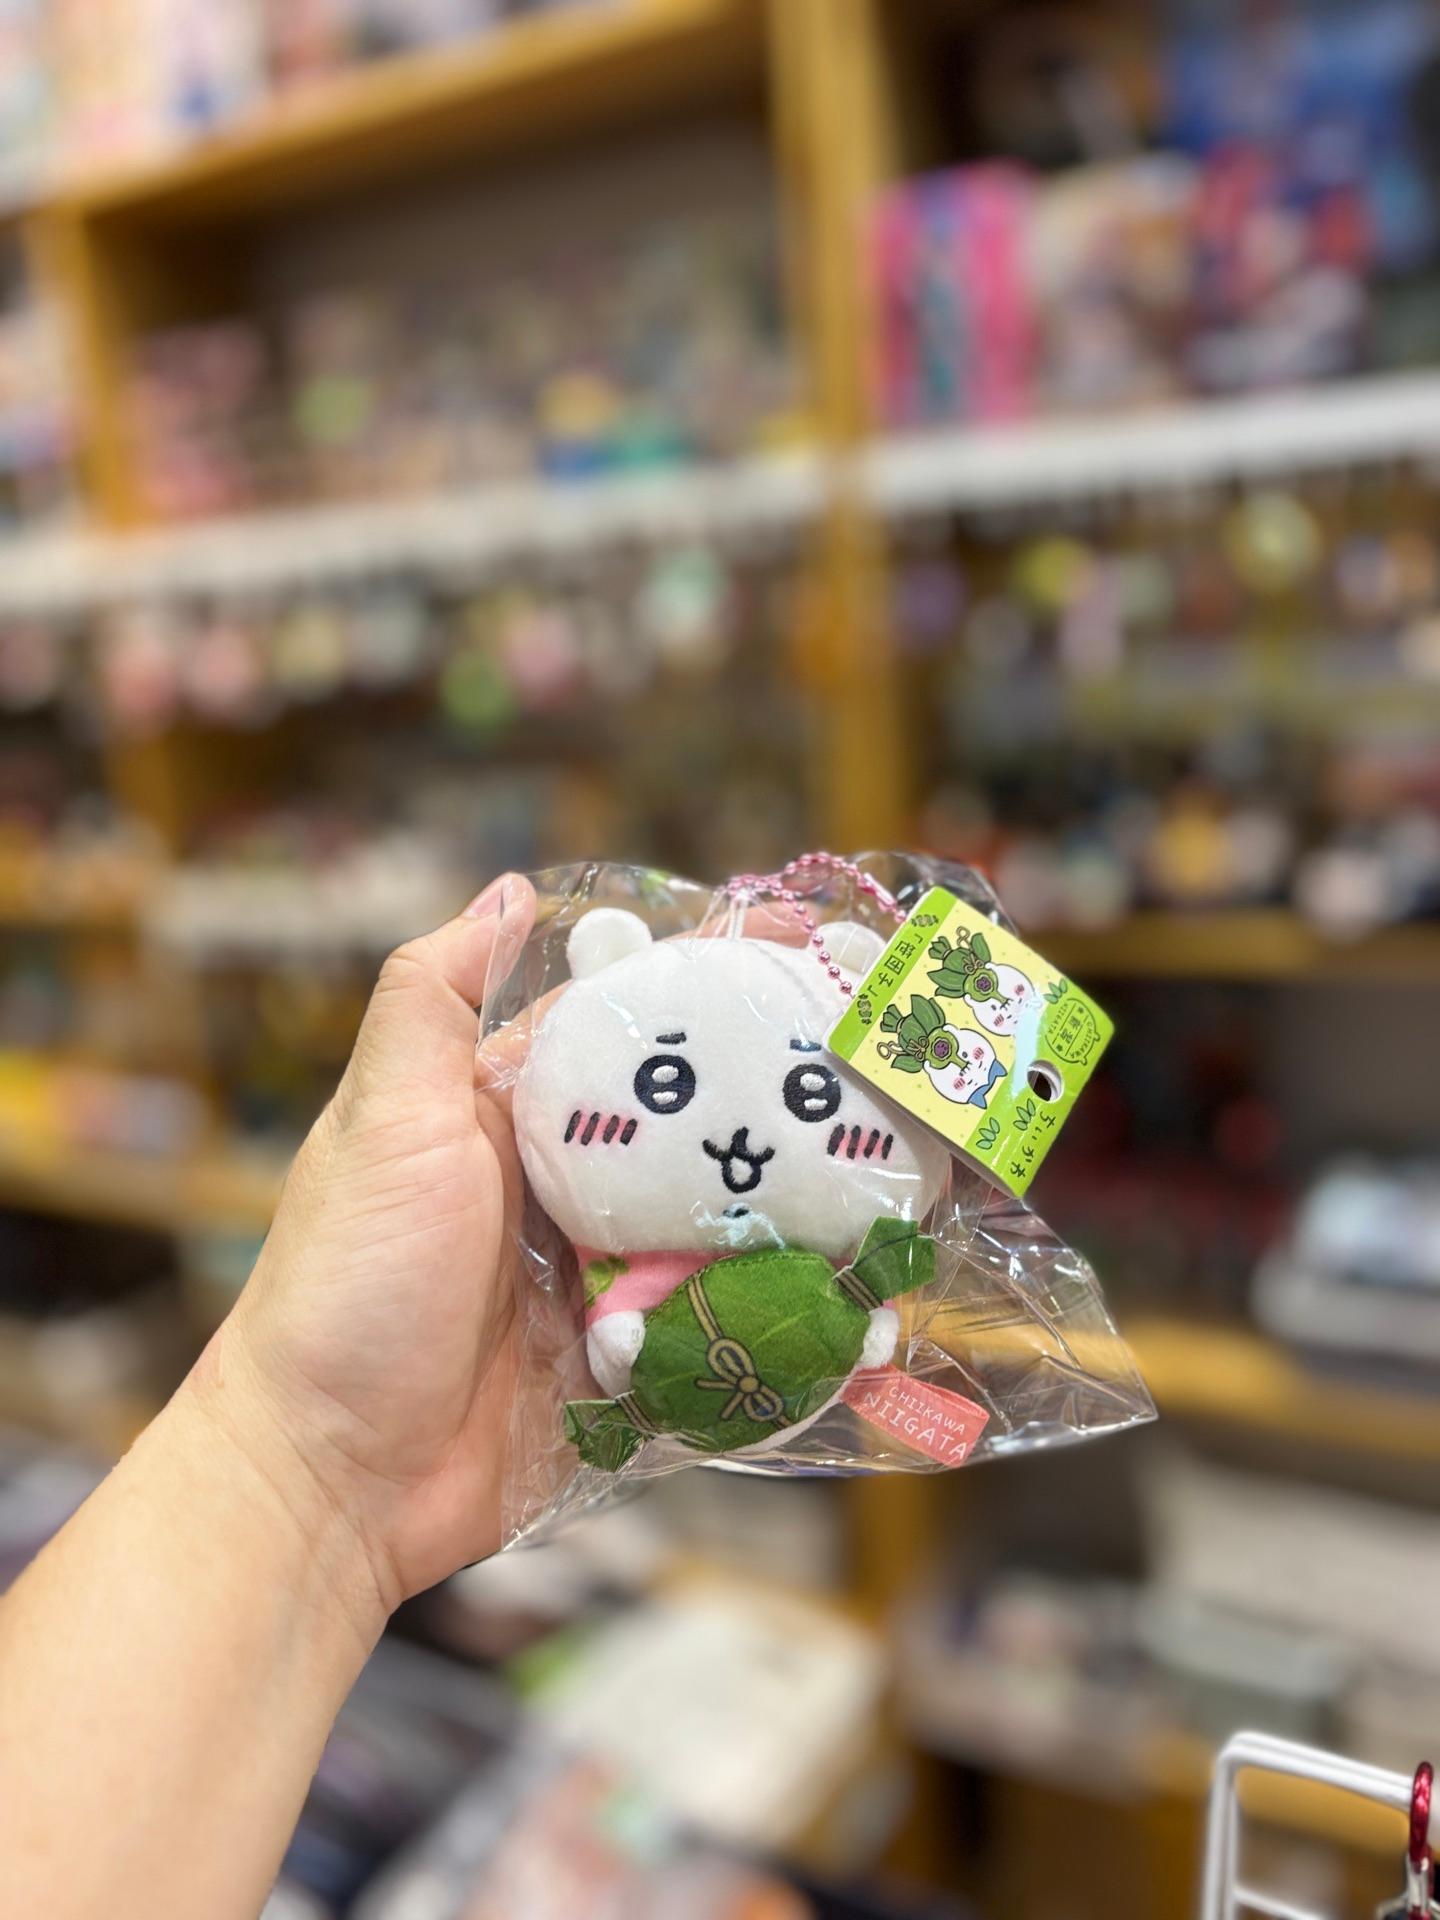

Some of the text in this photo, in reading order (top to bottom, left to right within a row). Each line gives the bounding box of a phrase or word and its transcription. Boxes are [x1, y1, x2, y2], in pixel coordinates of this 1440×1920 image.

[1010, 1111, 1056, 1177] ちいかわ
[864, 1392, 968, 1459] NIIGATA
[889, 1387, 965, 1435] CHIIKAWA
